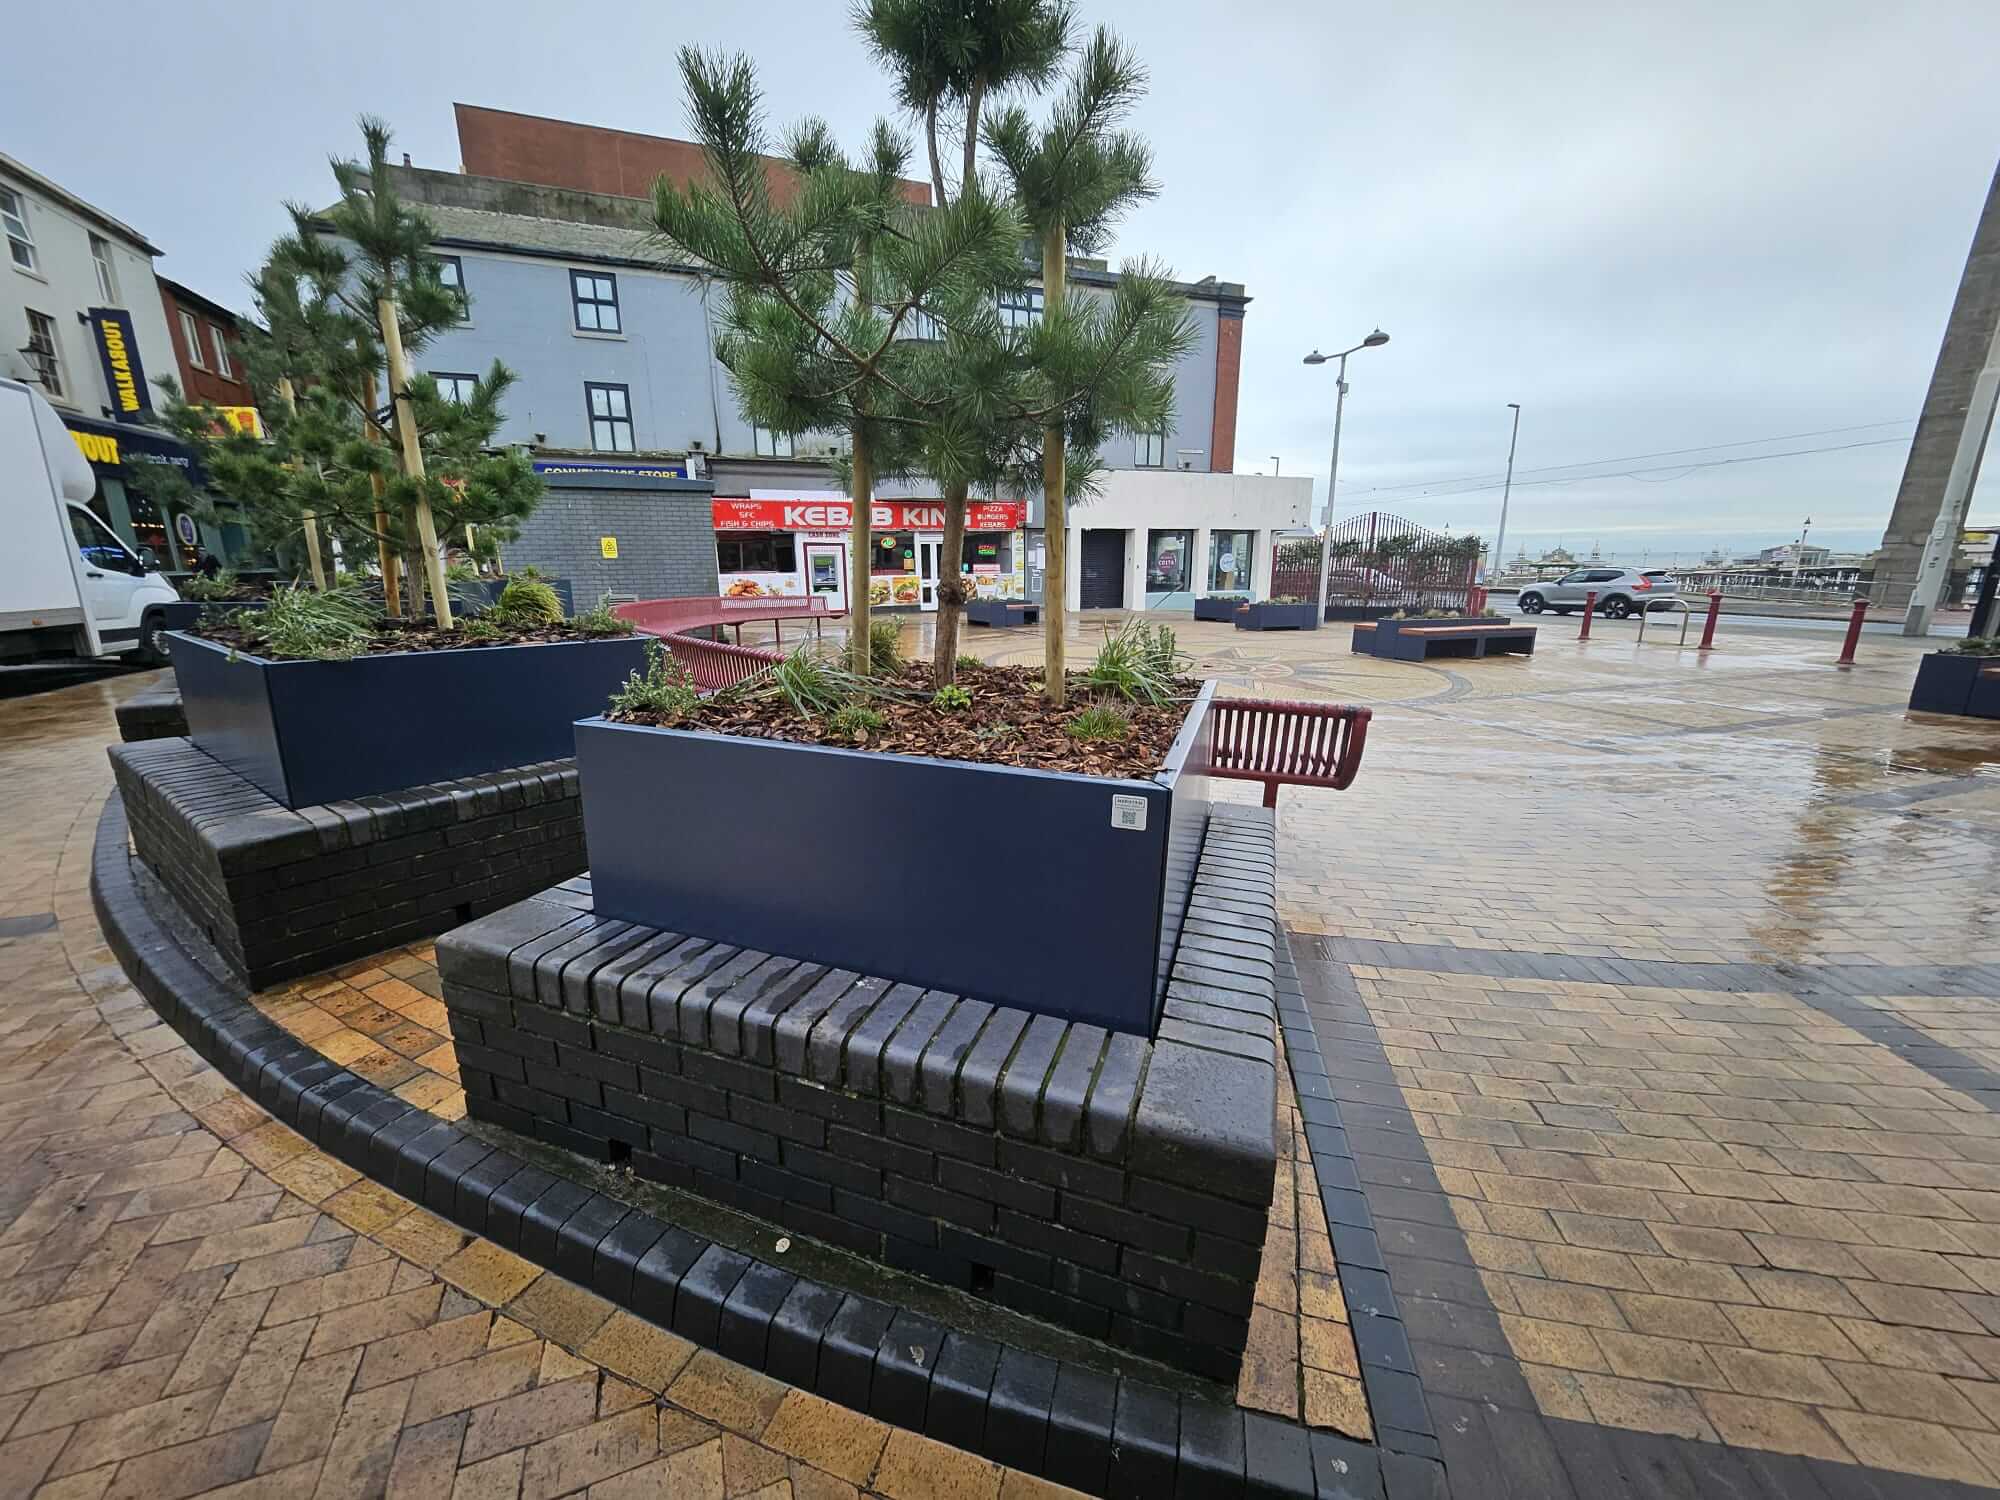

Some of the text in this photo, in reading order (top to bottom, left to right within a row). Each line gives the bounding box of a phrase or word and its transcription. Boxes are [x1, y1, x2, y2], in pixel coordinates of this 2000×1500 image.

[101, 319, 140, 411] WALKABOUT
[67, 430, 120, 465] OUT
[730, 502, 762, 510] WRAPS
[783, 506, 893, 526] KEBB
